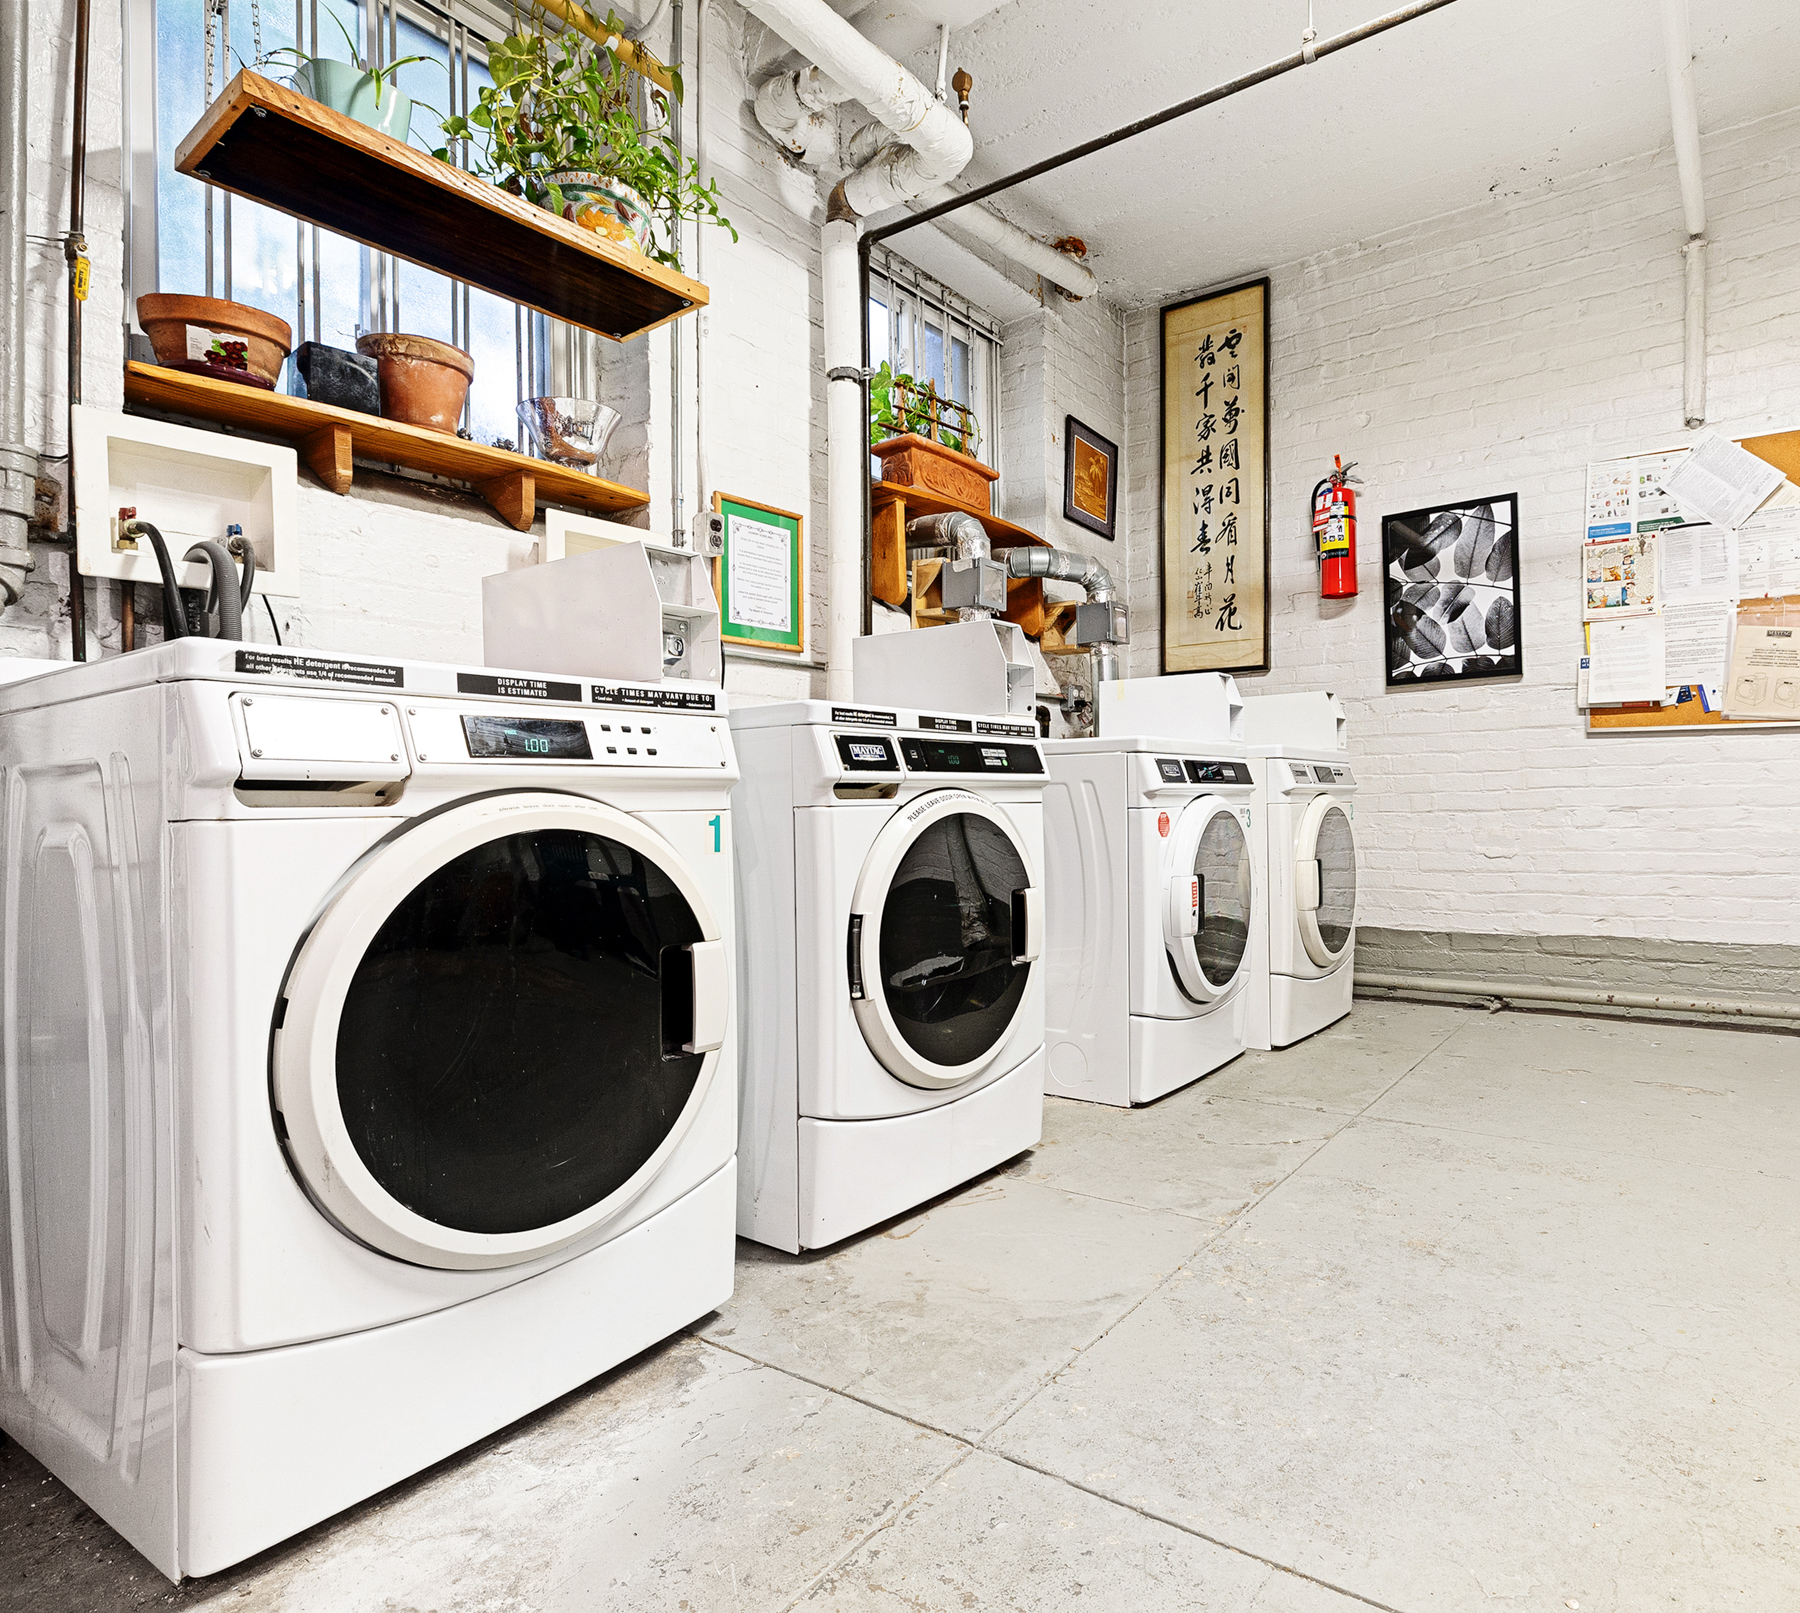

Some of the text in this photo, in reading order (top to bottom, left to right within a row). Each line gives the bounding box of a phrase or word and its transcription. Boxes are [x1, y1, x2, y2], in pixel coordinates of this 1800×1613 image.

[293, 656, 304, 666] HE
[306, 660, 340, 670] detergent
[335, 673, 374, 682] recommended
[497, 678, 547, 689] DISPLAY TIME
[507, 688, 548, 697] ESTIMATED
[594, 686, 619, 696] CYCLE
[621, 689, 644, 697] TIMES
[851, 746, 883, 755] MAYTAG
[907, 806, 926, 822] PLEASE
[926, 797, 941, 811] LEAVE
[939, 794, 954, 802] DOOR
[1350, 804, 1354, 820] 2
[1246, 809, 1251, 828] 3
[709, 815, 720, 852] 1
